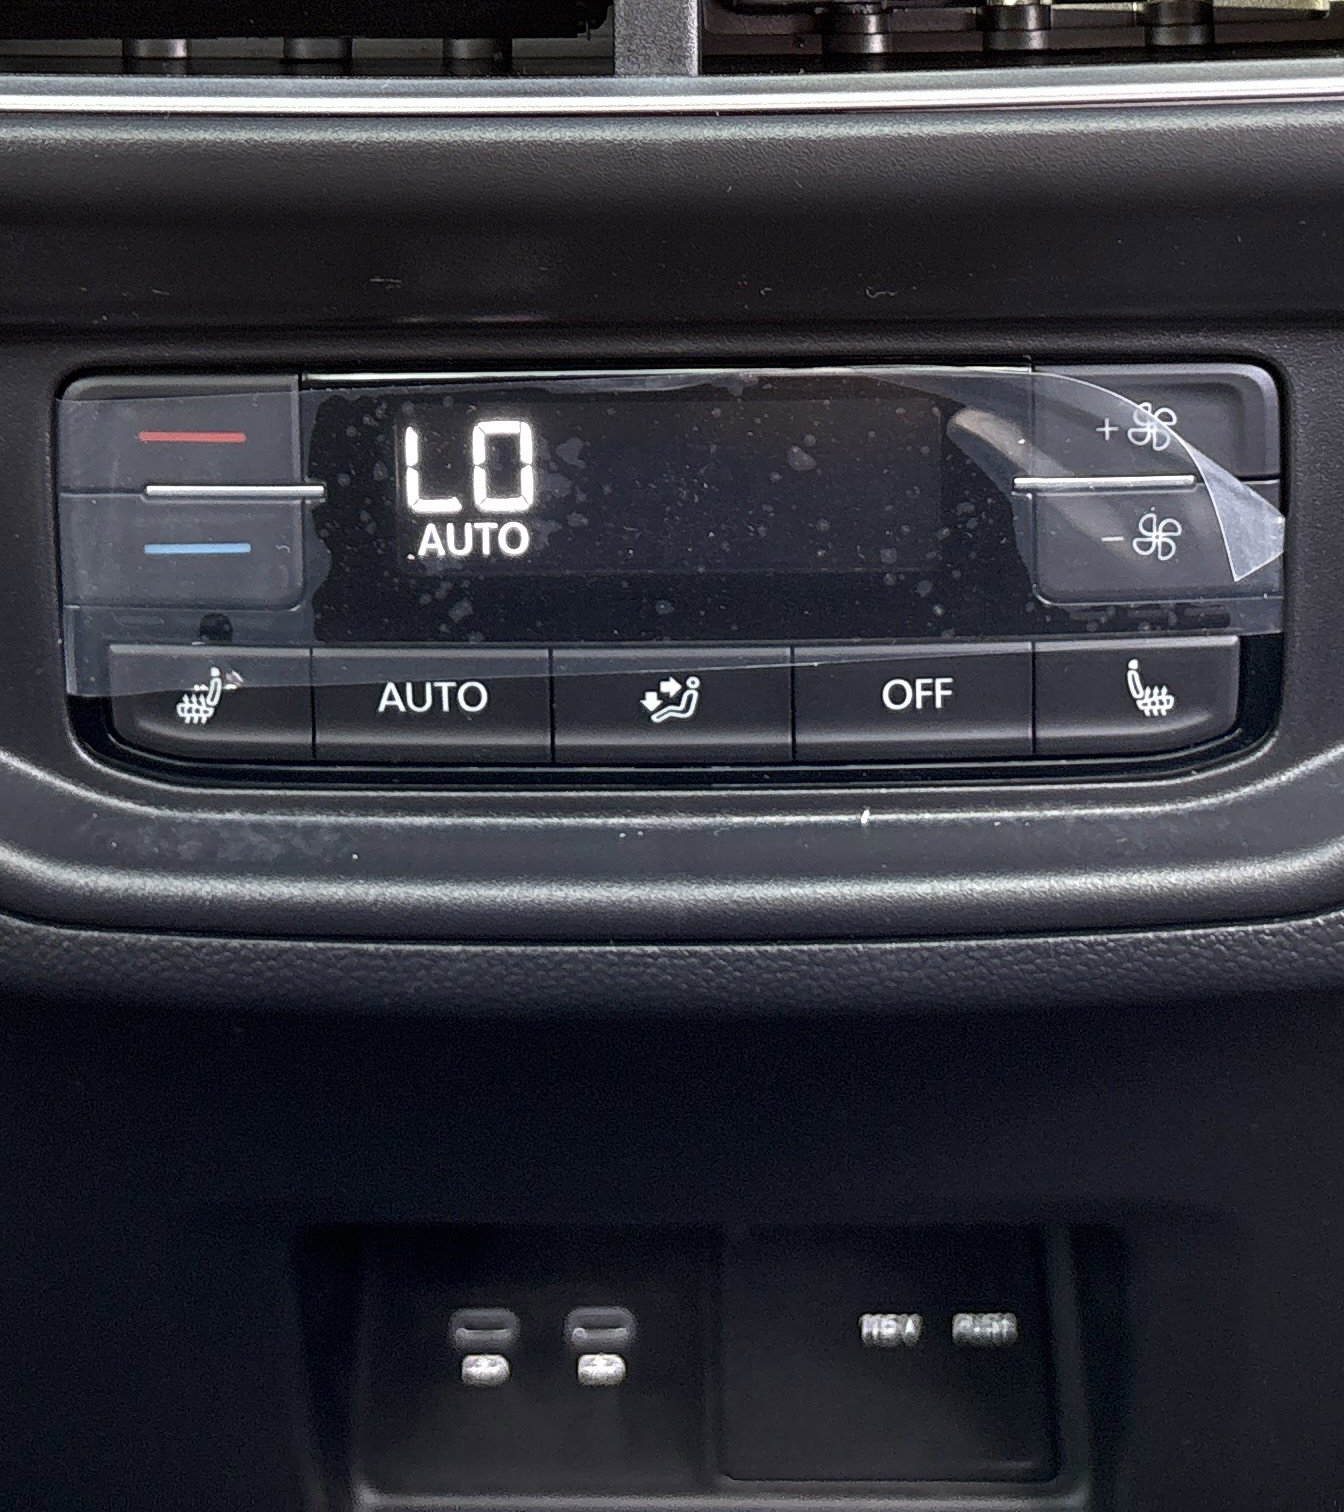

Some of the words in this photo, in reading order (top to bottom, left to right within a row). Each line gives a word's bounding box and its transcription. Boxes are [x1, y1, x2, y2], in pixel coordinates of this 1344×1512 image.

[404, 419, 534, 514] LO
[416, 520, 531, 558] AUTO
[376, 679, 489, 714] AUTO
[880, 676, 954, 711] OFF
